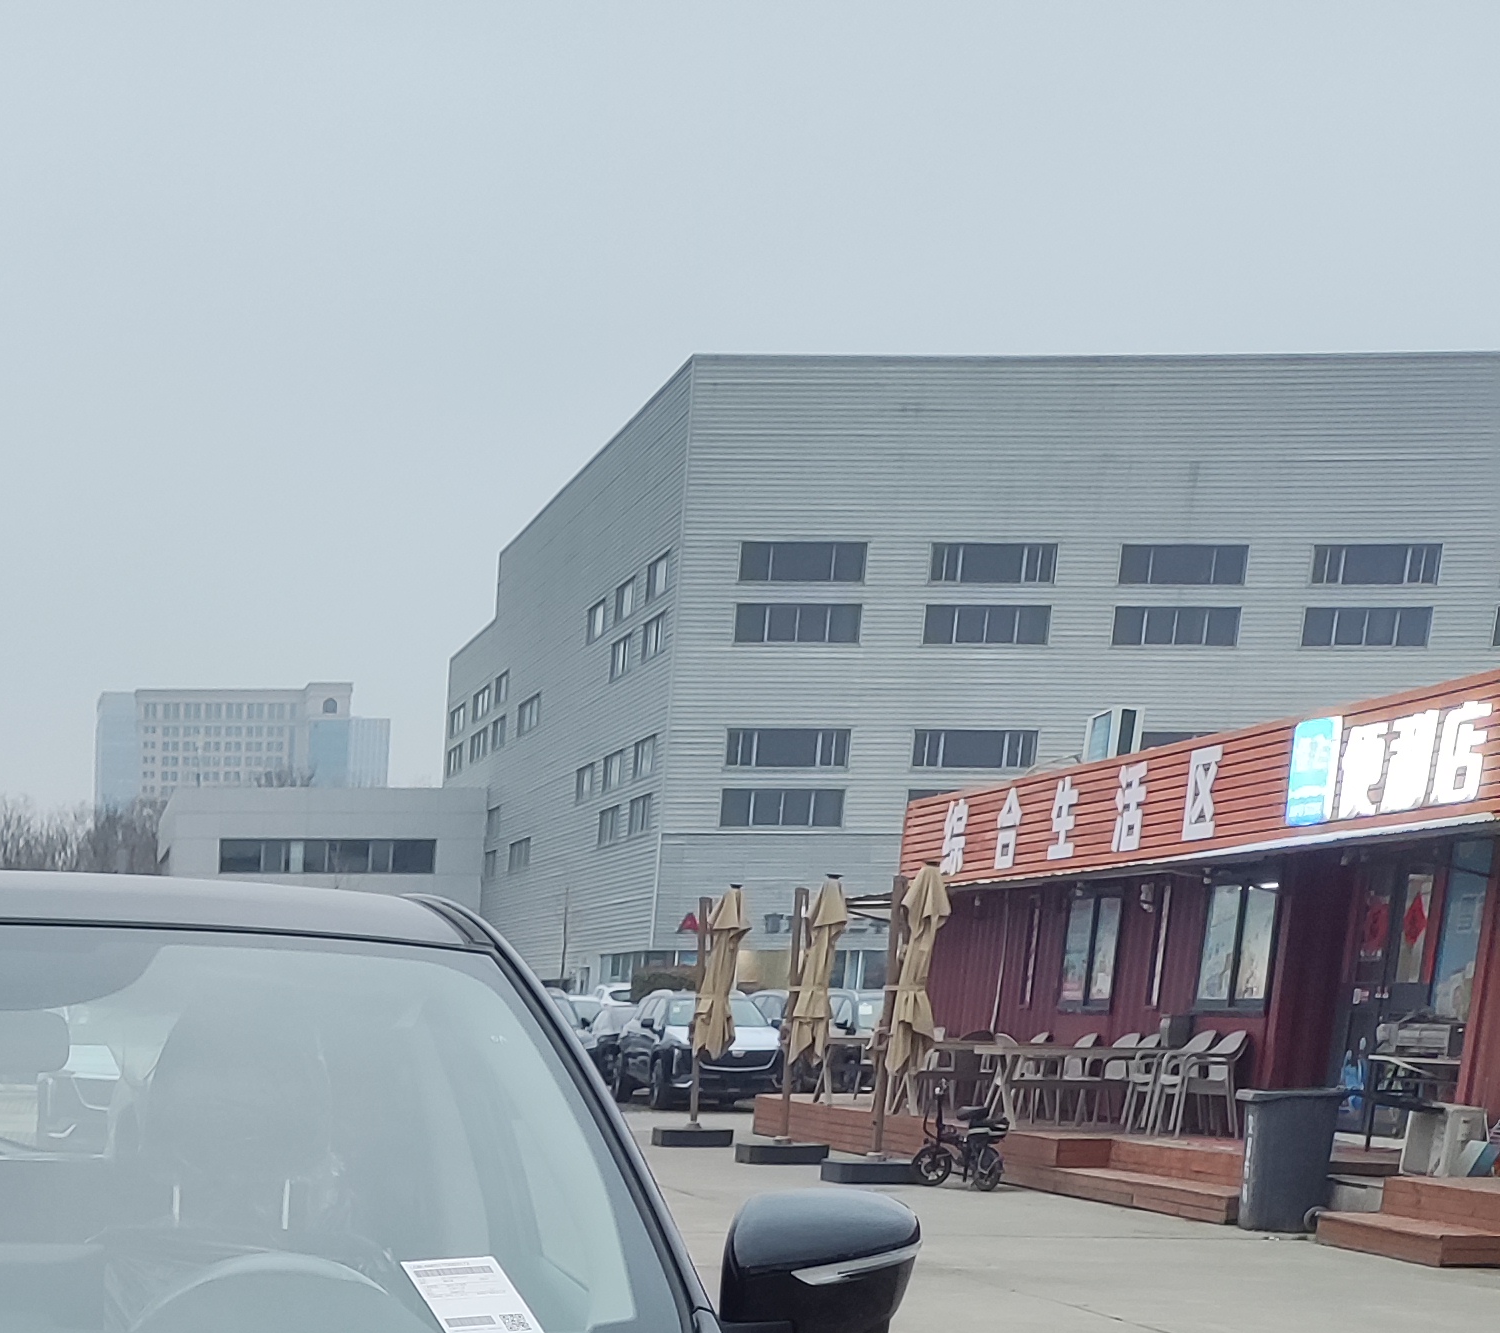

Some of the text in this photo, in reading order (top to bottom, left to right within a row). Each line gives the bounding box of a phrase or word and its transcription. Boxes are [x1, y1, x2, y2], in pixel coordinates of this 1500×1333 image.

[939, 744, 1224, 876] 综合生活区
